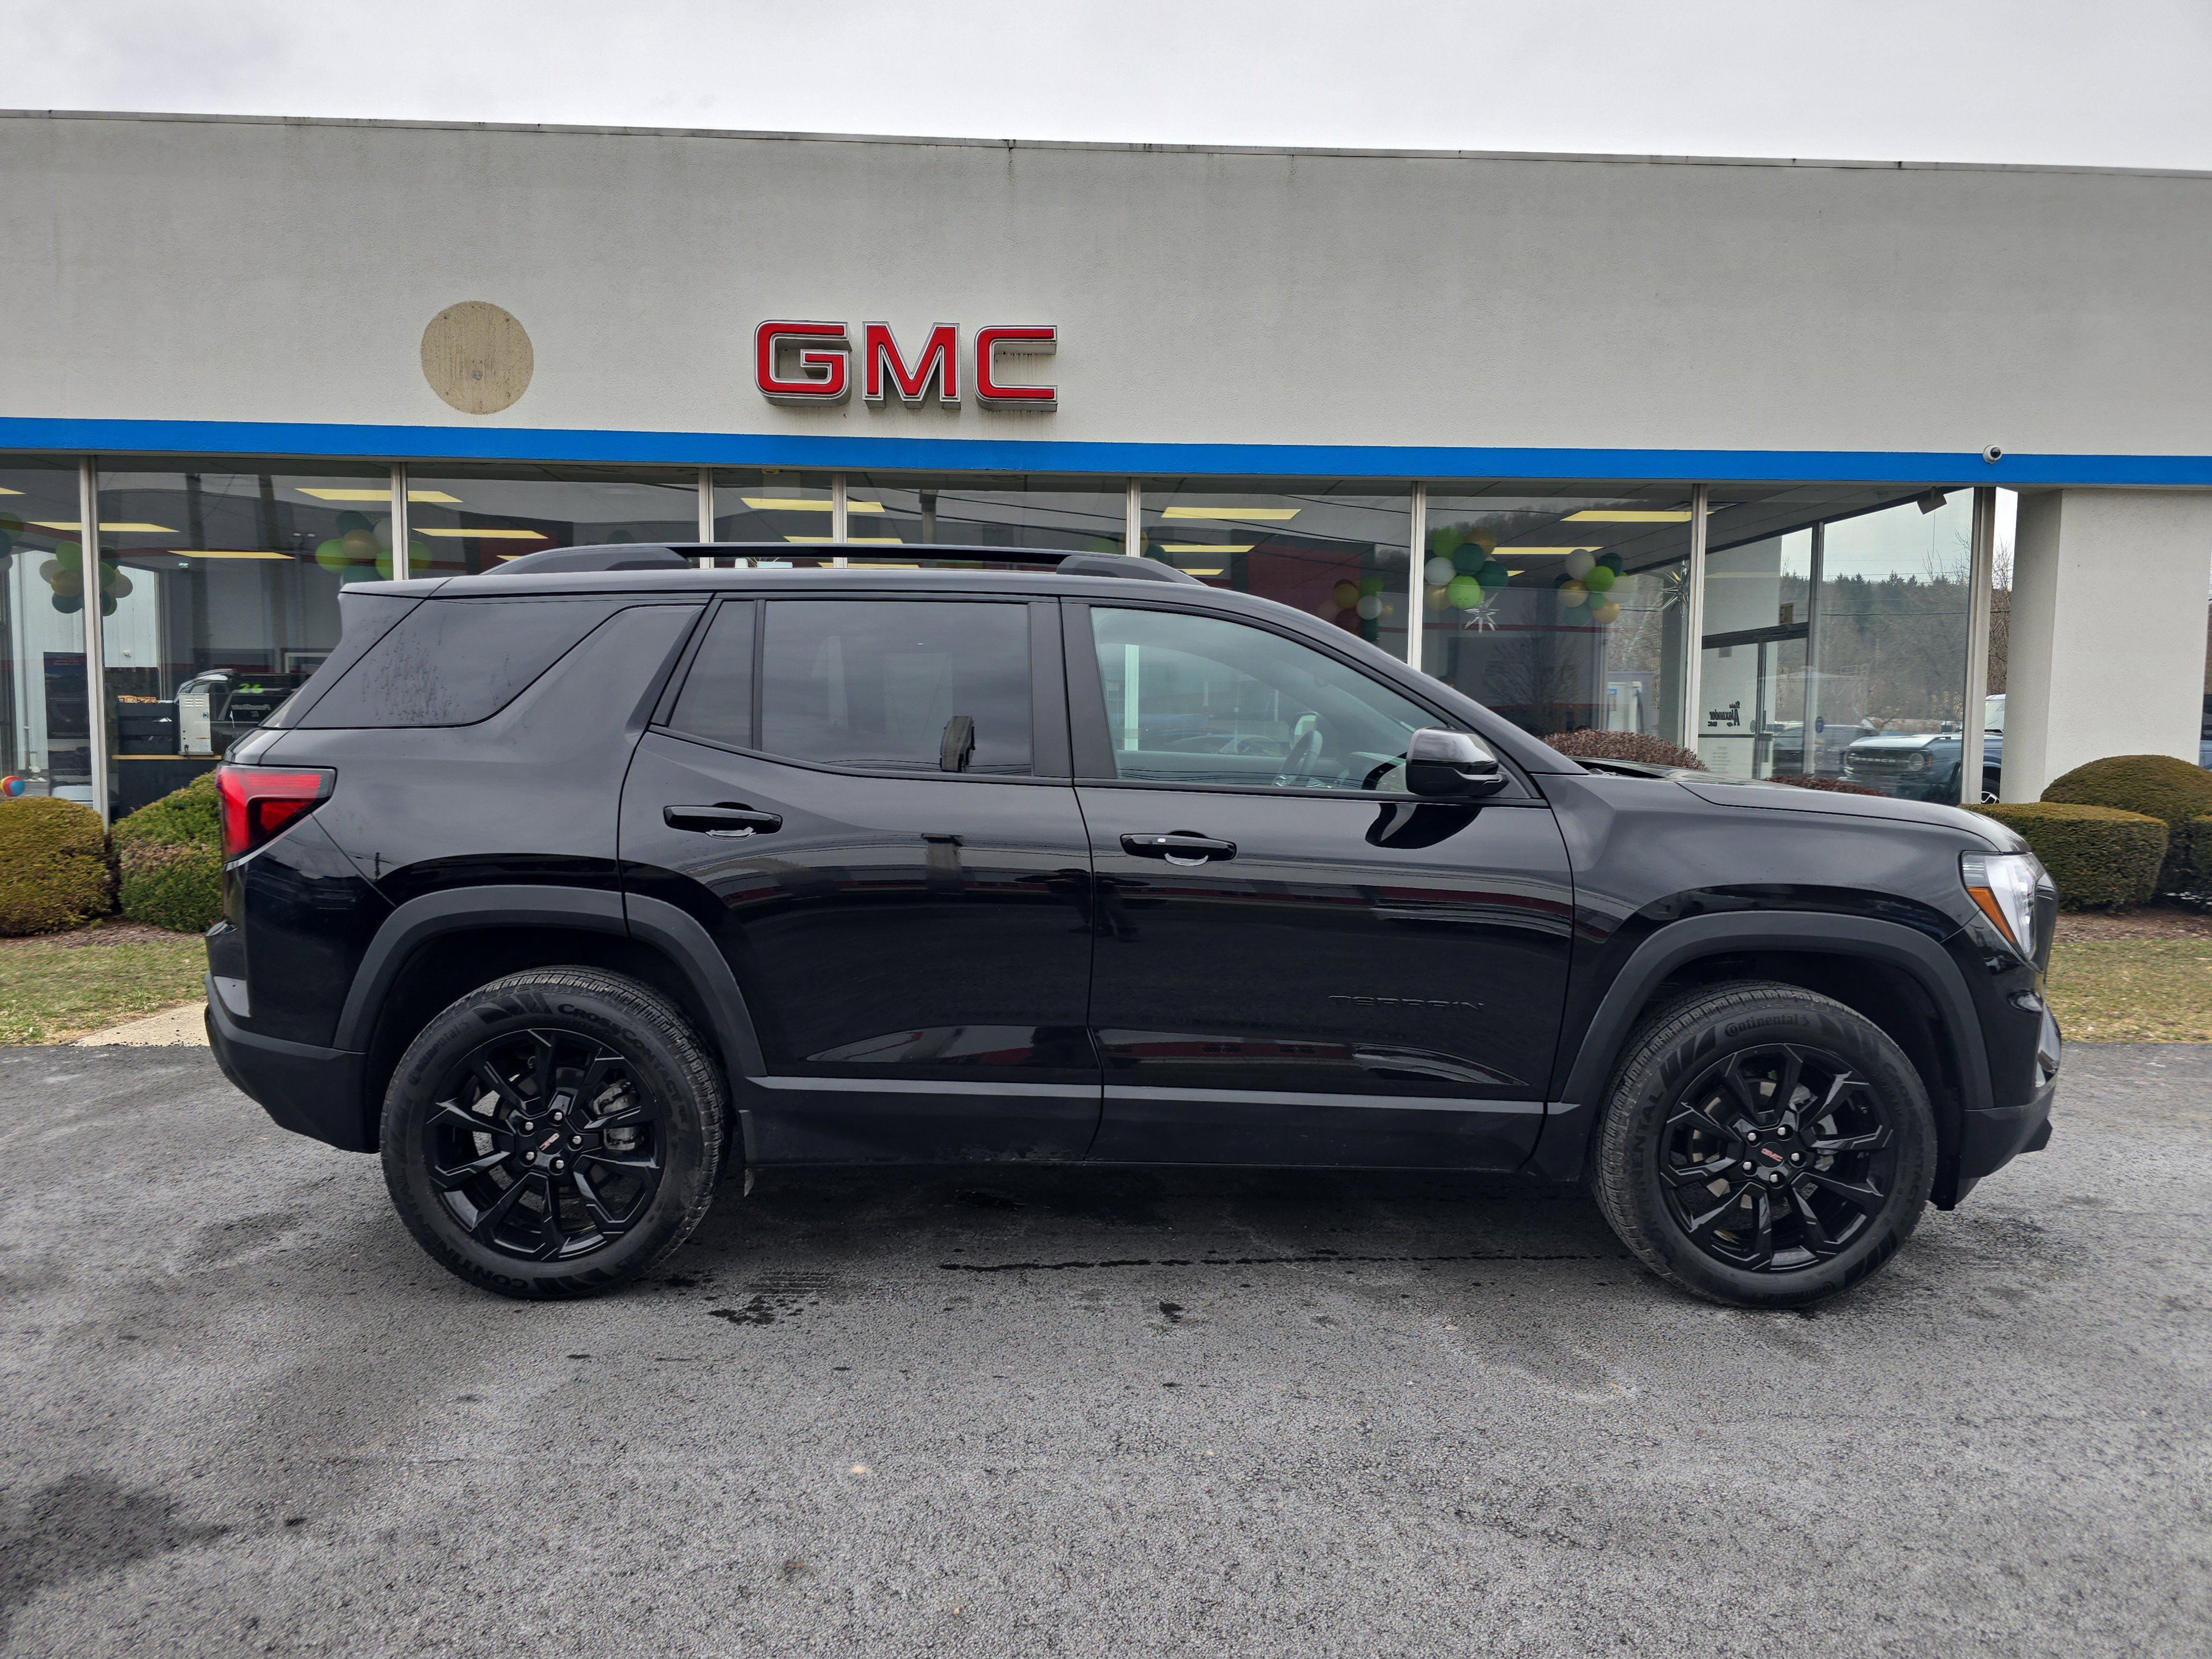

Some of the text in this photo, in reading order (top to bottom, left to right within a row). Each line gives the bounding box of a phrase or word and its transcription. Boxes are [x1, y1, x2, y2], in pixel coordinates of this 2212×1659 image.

[754, 319, 1058, 411] GMC
[1328, 995, 1484, 1011] TERRAIN
[1725, 1013, 1798, 1037] Continental
[1760, 1148, 1784, 1162] GMC
